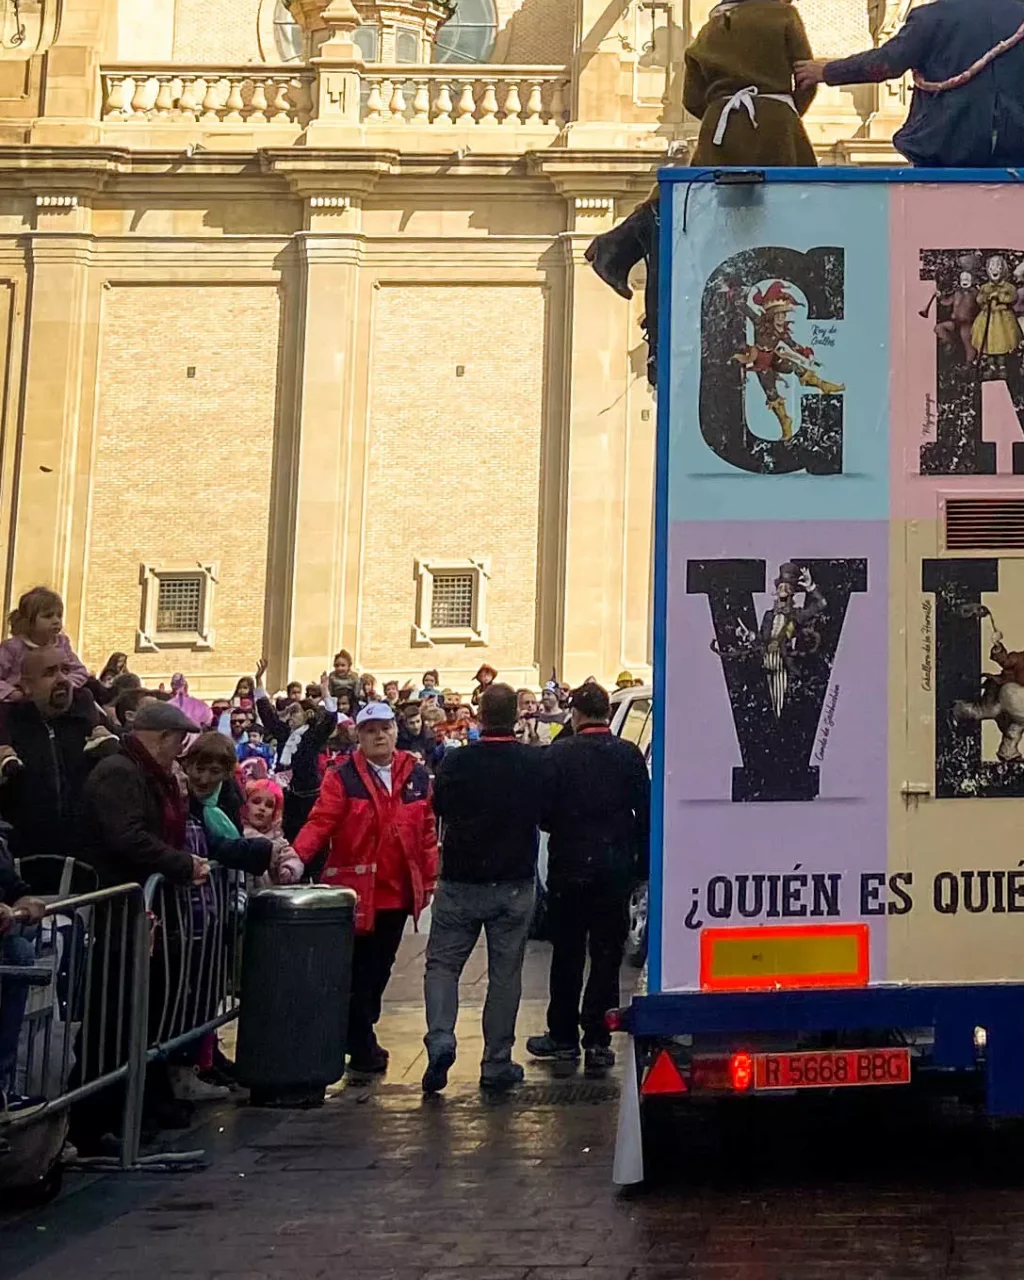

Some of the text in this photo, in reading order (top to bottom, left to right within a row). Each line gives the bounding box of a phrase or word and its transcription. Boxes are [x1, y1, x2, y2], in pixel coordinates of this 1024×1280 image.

[687, 558, 867, 802] V
[685, 863, 842, 929] ¿QUIÉN
[860, 872, 913, 915] ES
[765, 1053, 902, 1086] R 5668 BBG
